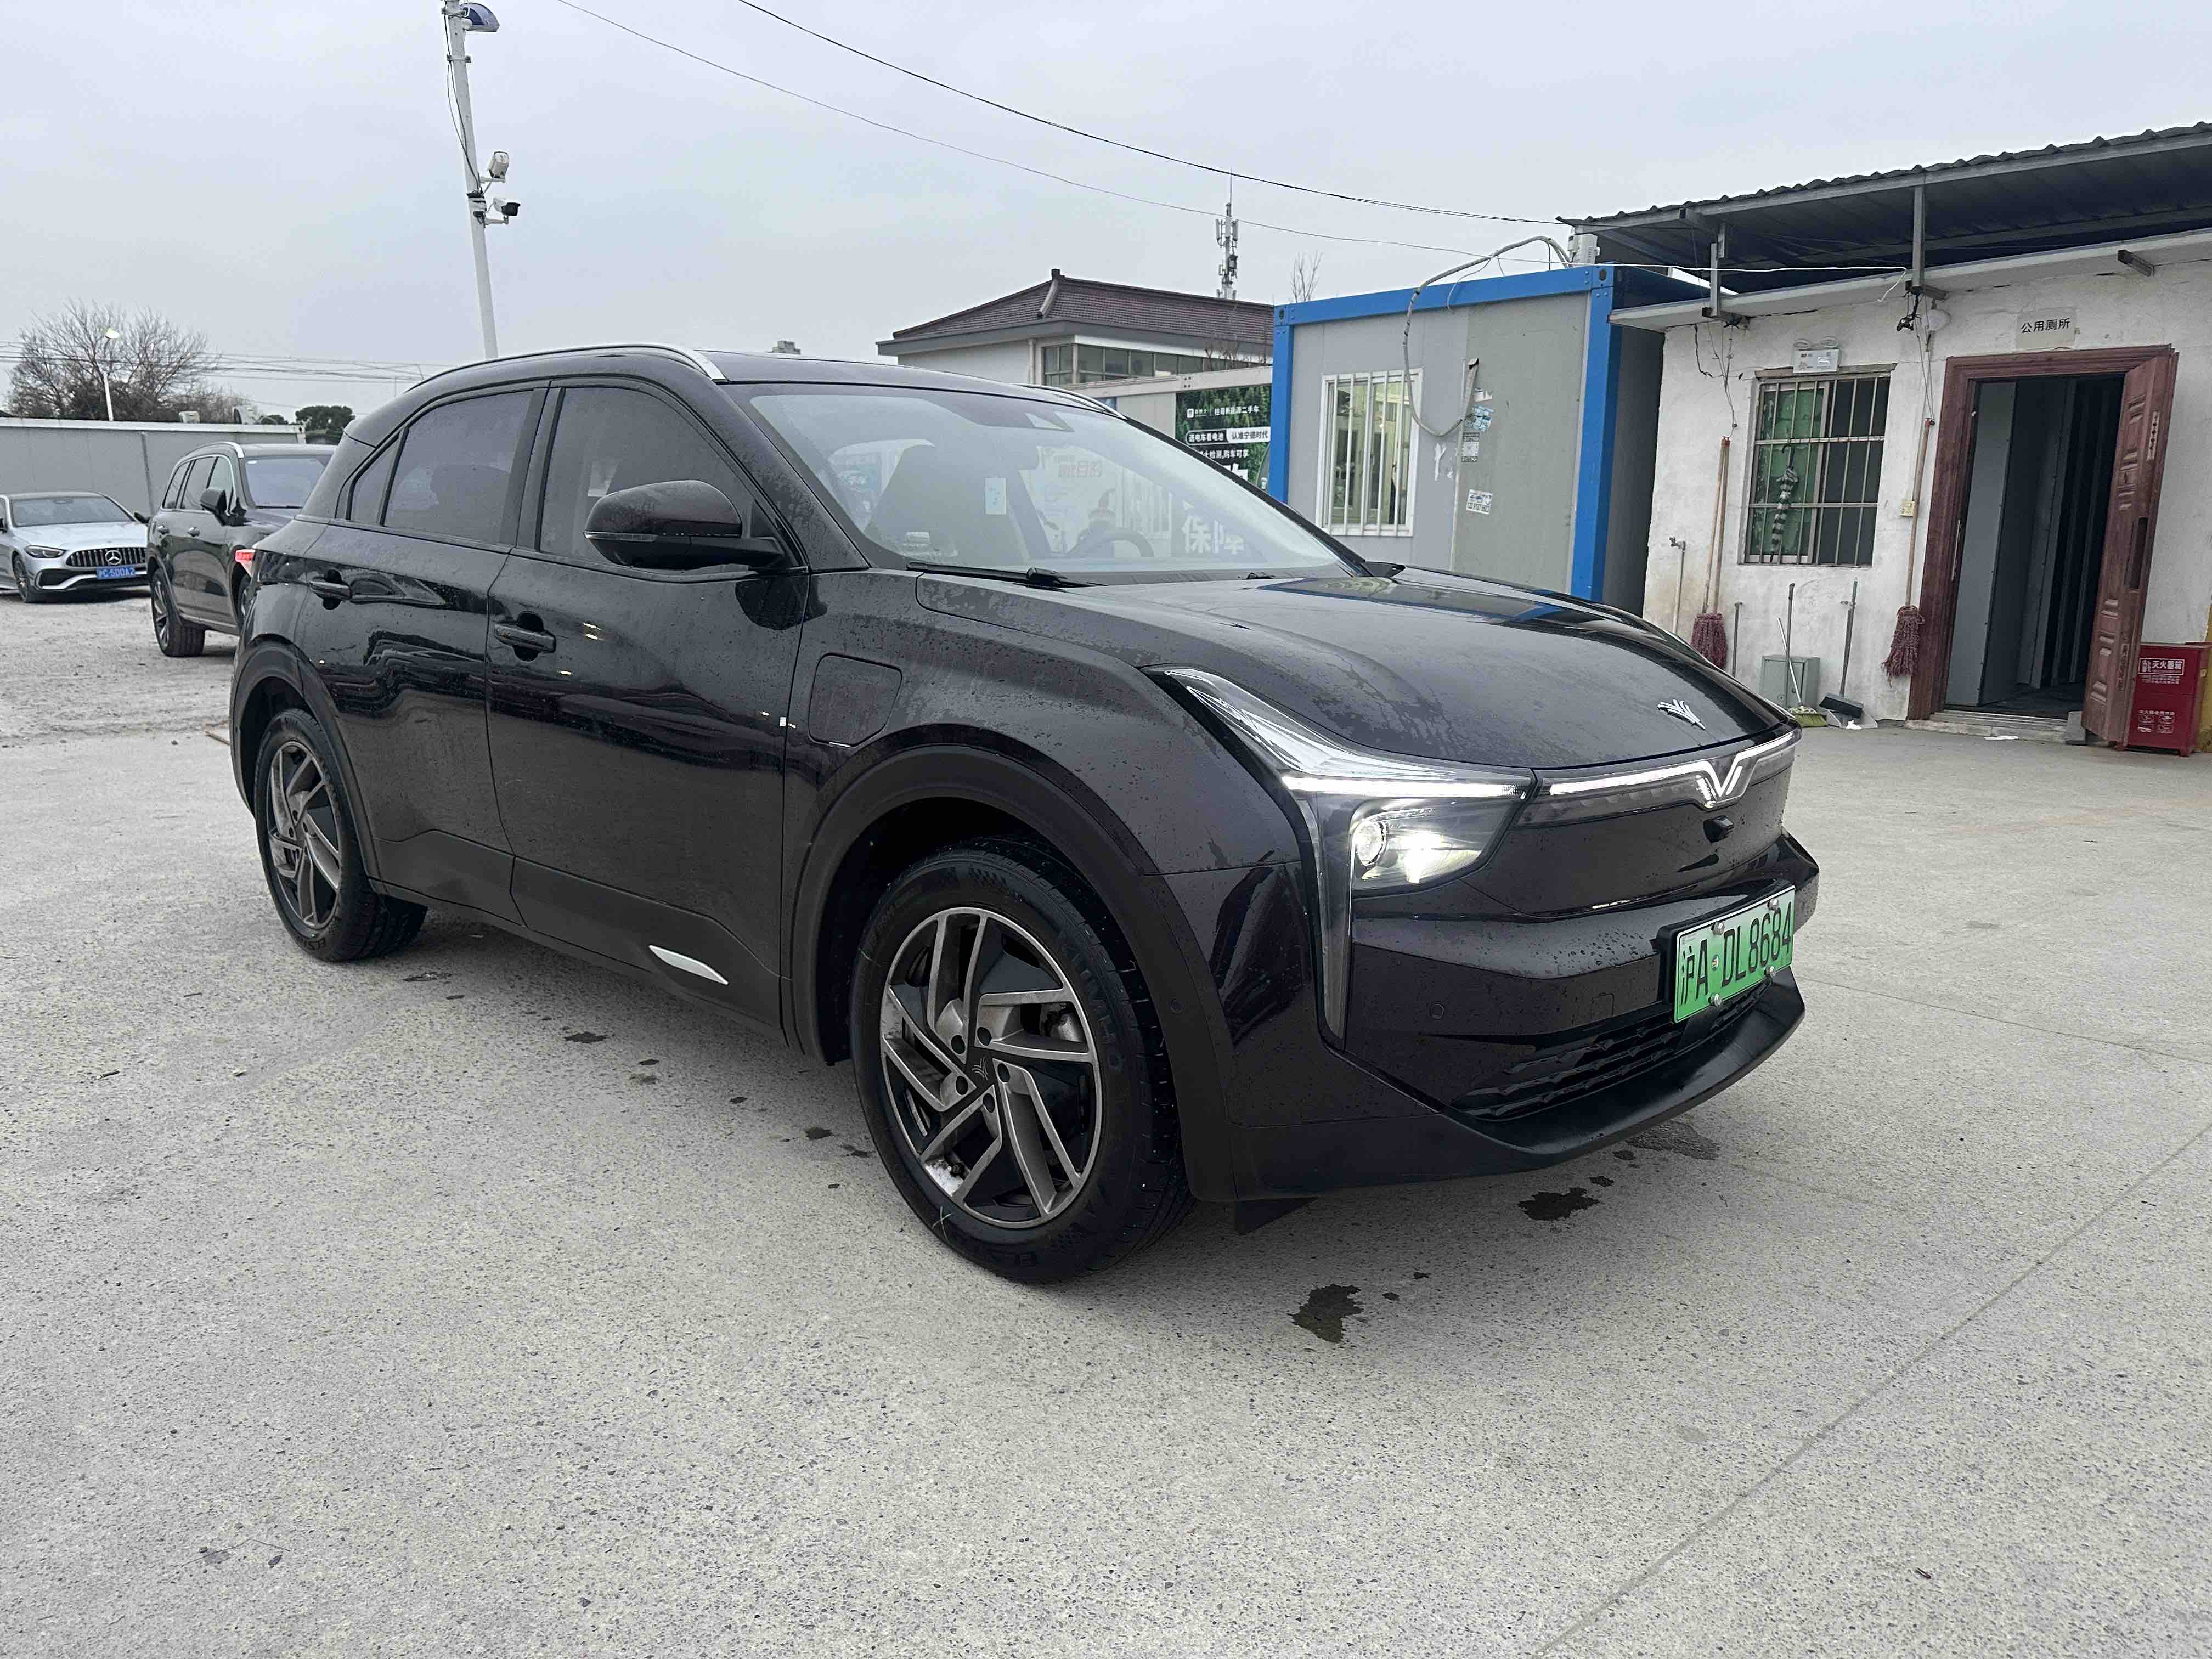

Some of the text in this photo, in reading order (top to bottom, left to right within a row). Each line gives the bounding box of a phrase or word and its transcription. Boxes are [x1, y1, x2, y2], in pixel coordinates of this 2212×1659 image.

[2020, 318, 2070, 334] 公用厕所
[1232, 430, 1268, 439] 认准宁德时代
